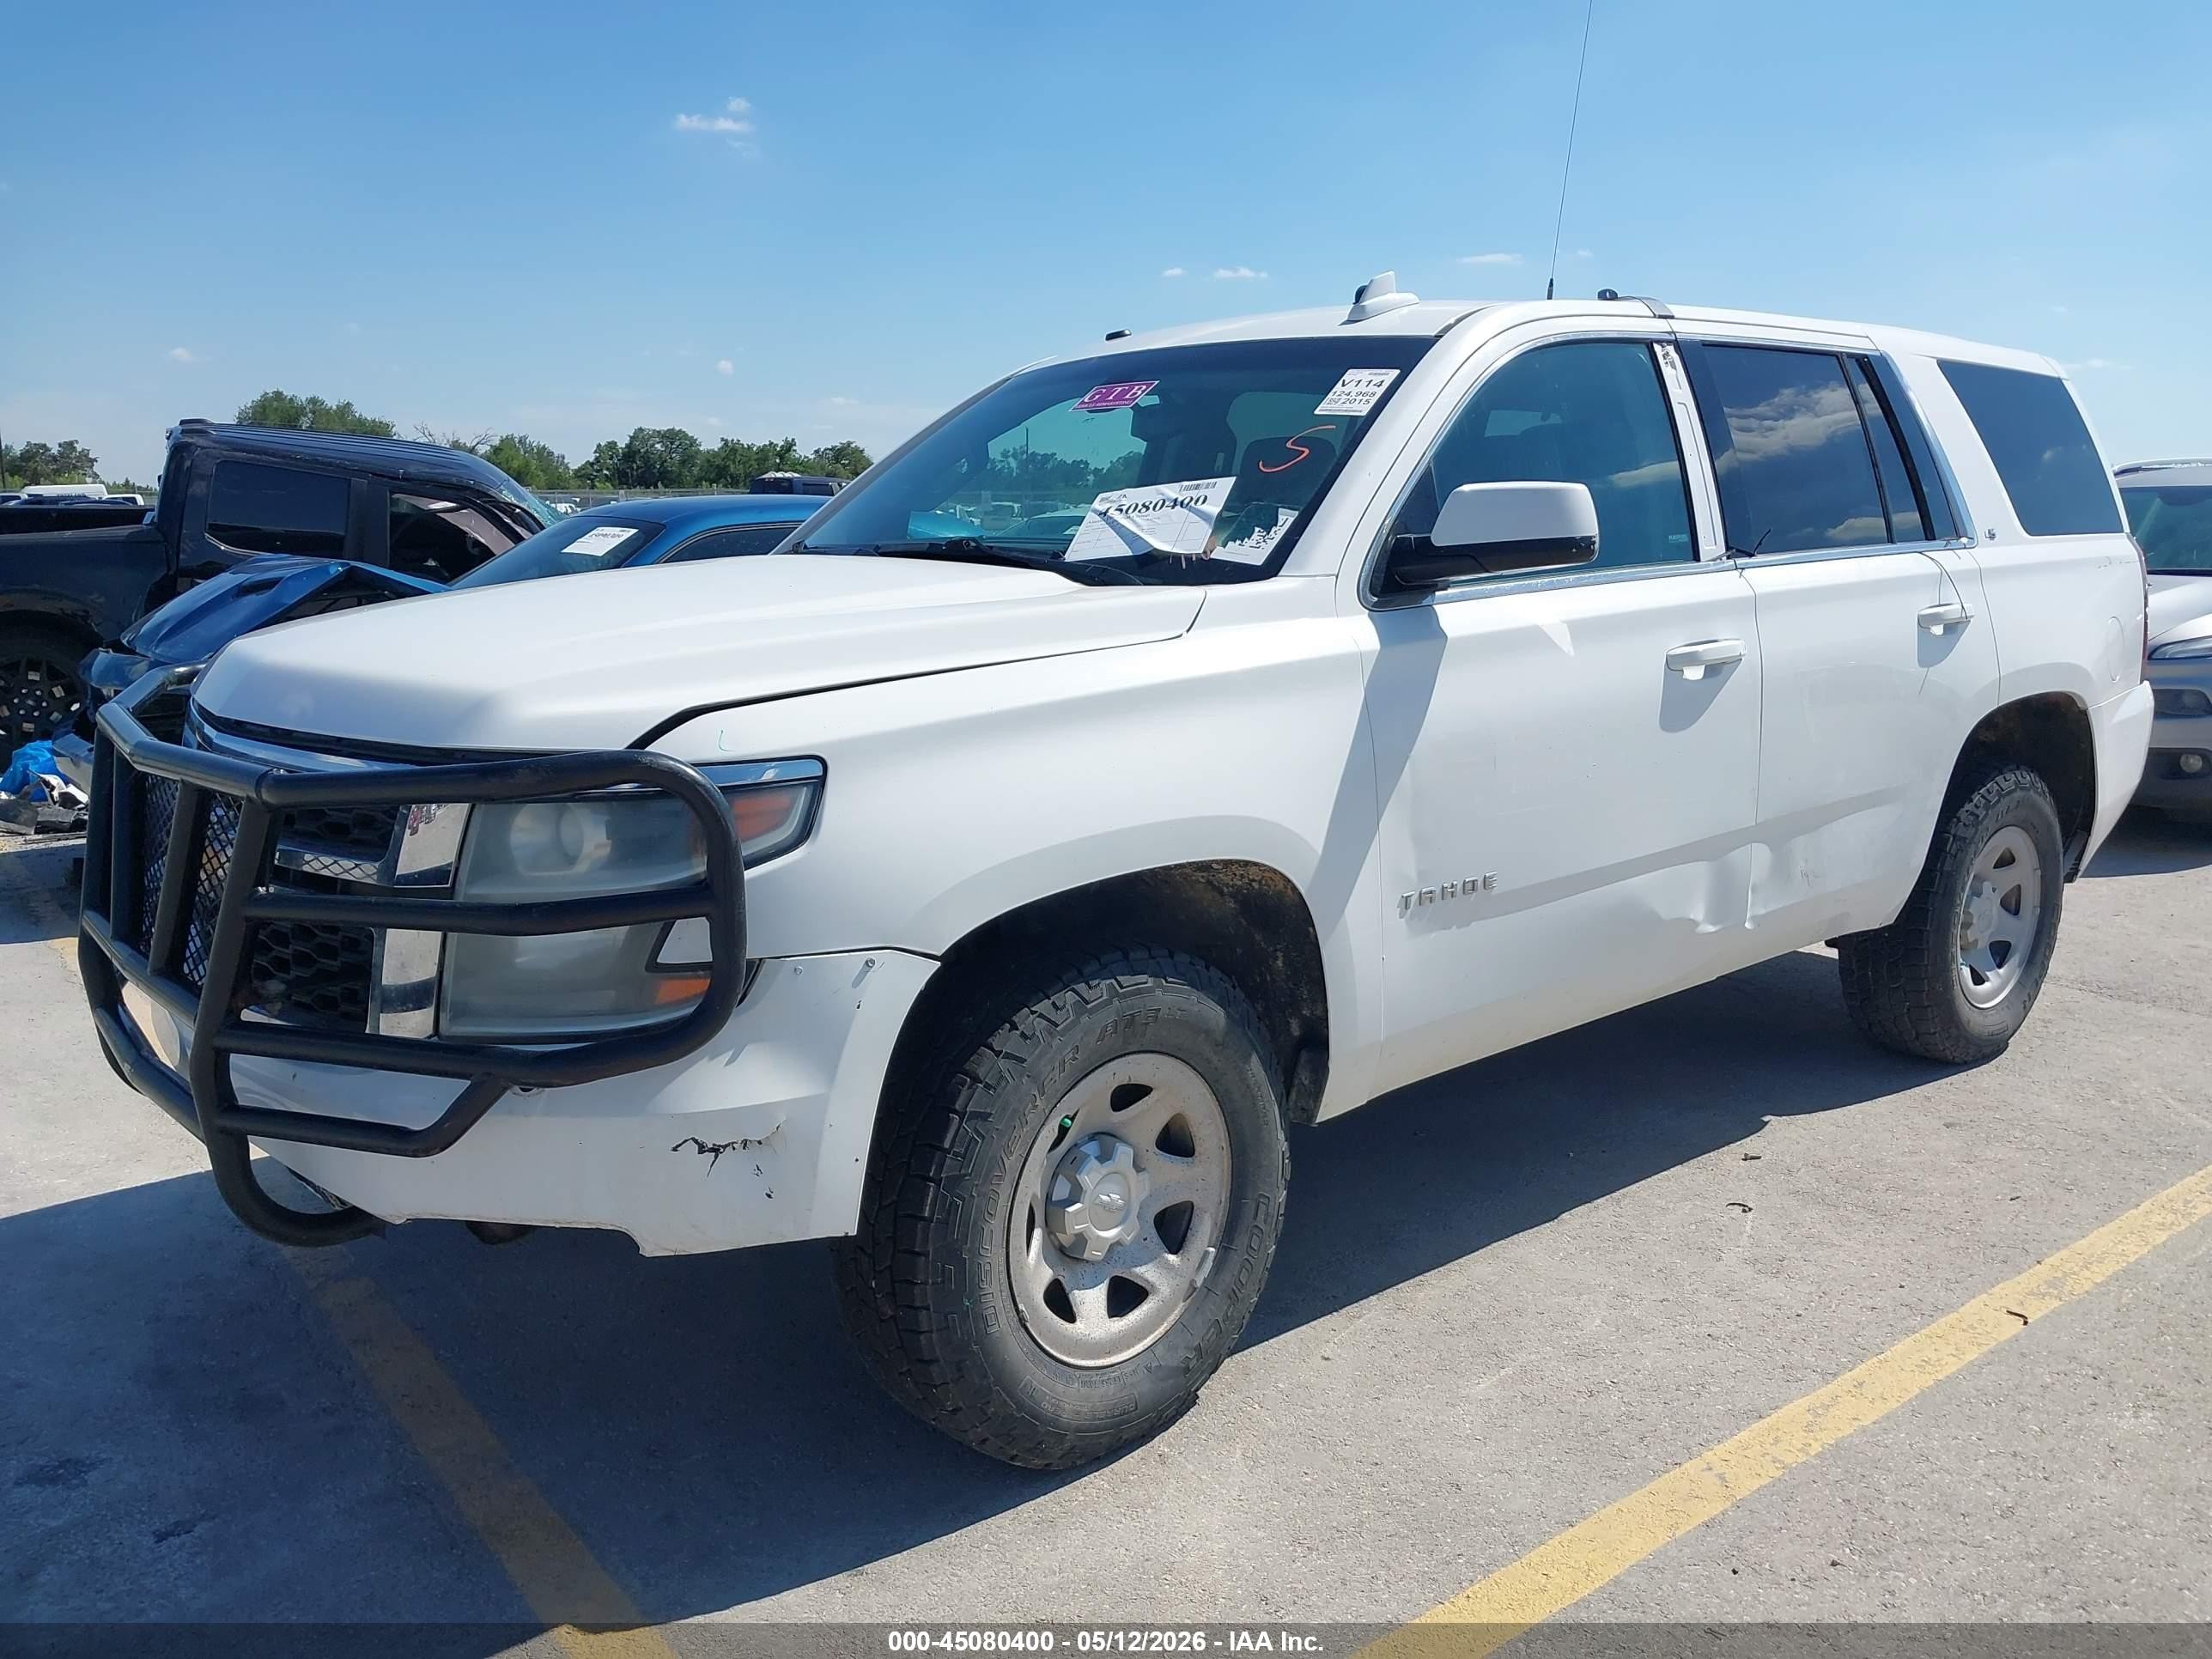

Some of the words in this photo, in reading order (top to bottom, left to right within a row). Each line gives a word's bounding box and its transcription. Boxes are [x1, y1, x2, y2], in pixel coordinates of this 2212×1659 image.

[1084, 385, 1147, 403] GTB
[1331, 390, 1377, 398] 124,968
[1341, 379, 1386, 388] V114
[1097, 494, 1208, 518] 45080400
[1401, 871, 1498, 910] TAHOE
[977, 1043, 1081, 1334] DISCOVERER
